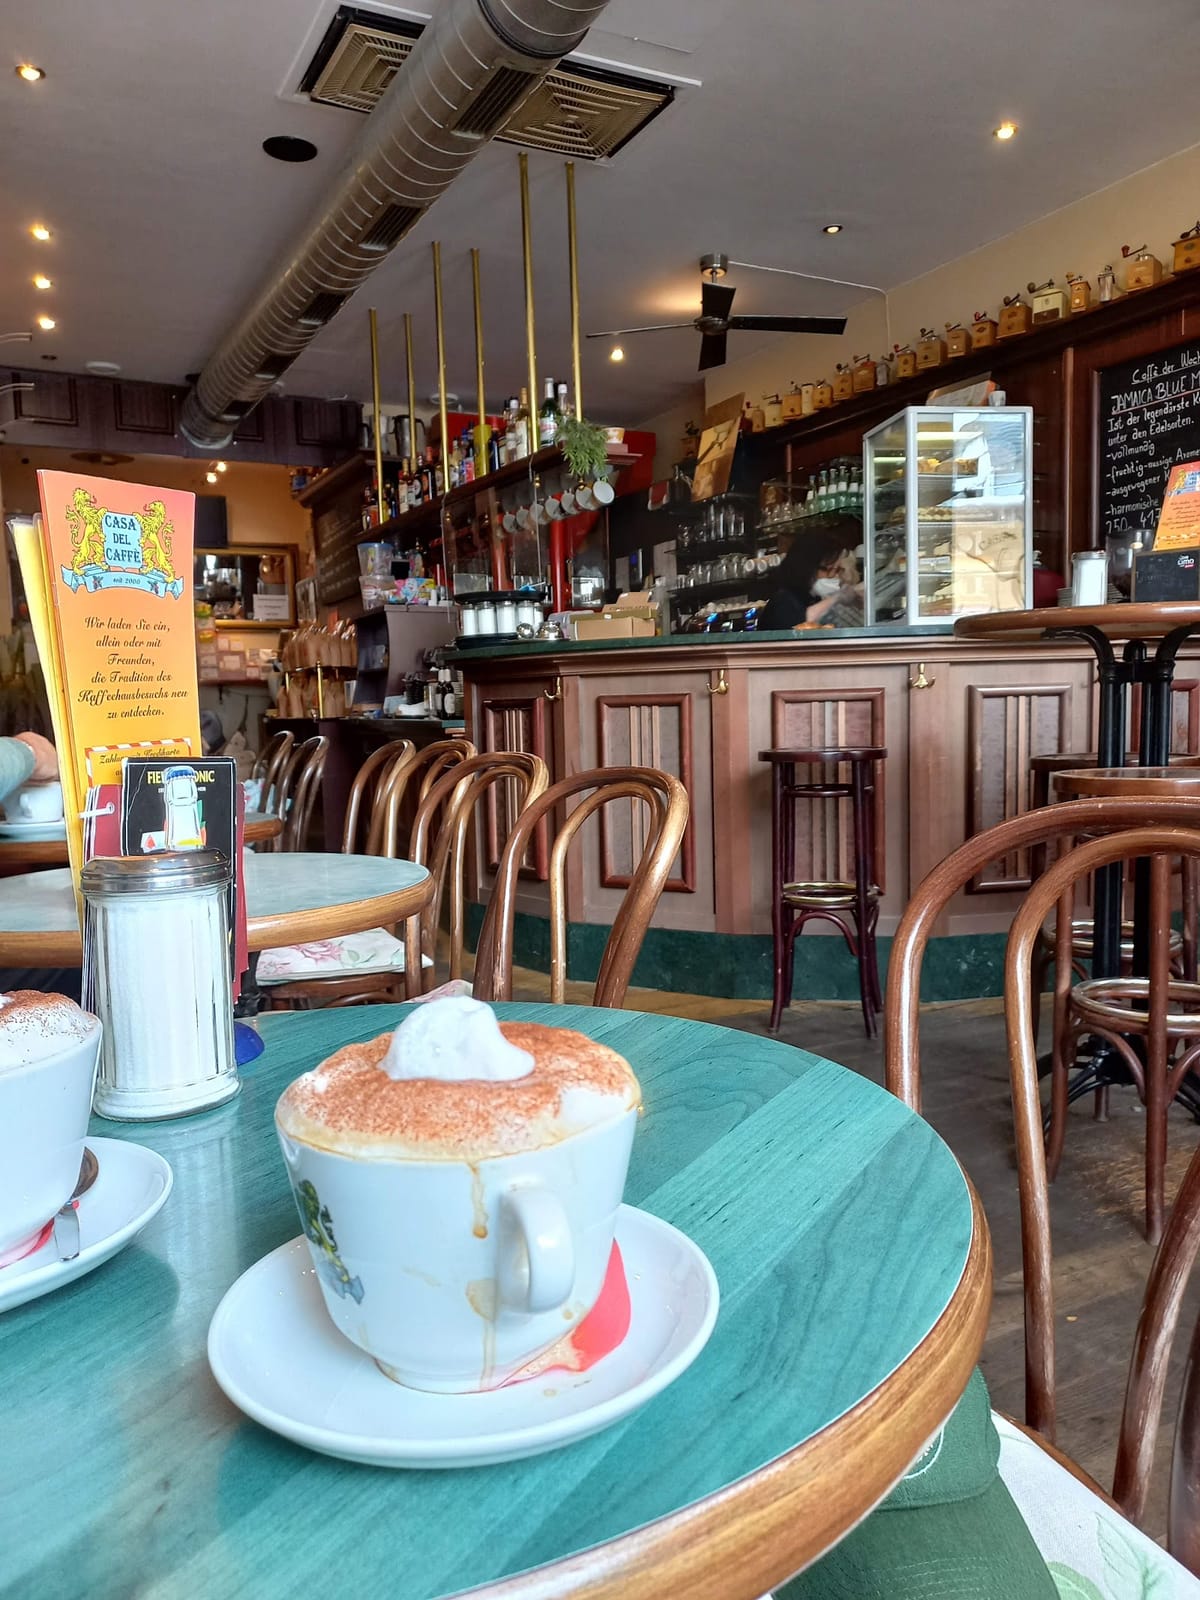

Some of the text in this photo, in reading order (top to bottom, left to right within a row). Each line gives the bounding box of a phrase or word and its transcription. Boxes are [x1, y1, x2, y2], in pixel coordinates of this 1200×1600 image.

[1162, 361, 1175, 375] der
[1155, 375, 1187, 399] BLUE
[1107, 416, 1124, 433] Ist
[1127, 411, 1140, 426] der
[1143, 397, 1190, 424] legendärste
[1132, 427, 1148, 441] den
[105, 514, 137, 531] CASA
[112, 532, 132, 546] DEL
[105, 547, 141, 563] CAFFÈ
[84, 616, 170, 633] Wir laden Sie ein,
[96, 635, 161, 648] allein oder mit
[108, 653, 155, 667] Freunden,
[91, 670, 172, 684] die Tradition des
[78, 687, 188, 707] Kaffeehausbesuchs neu
[107, 704, 165, 719] zu entdecken.
[195, 770, 215, 783] ONIC
